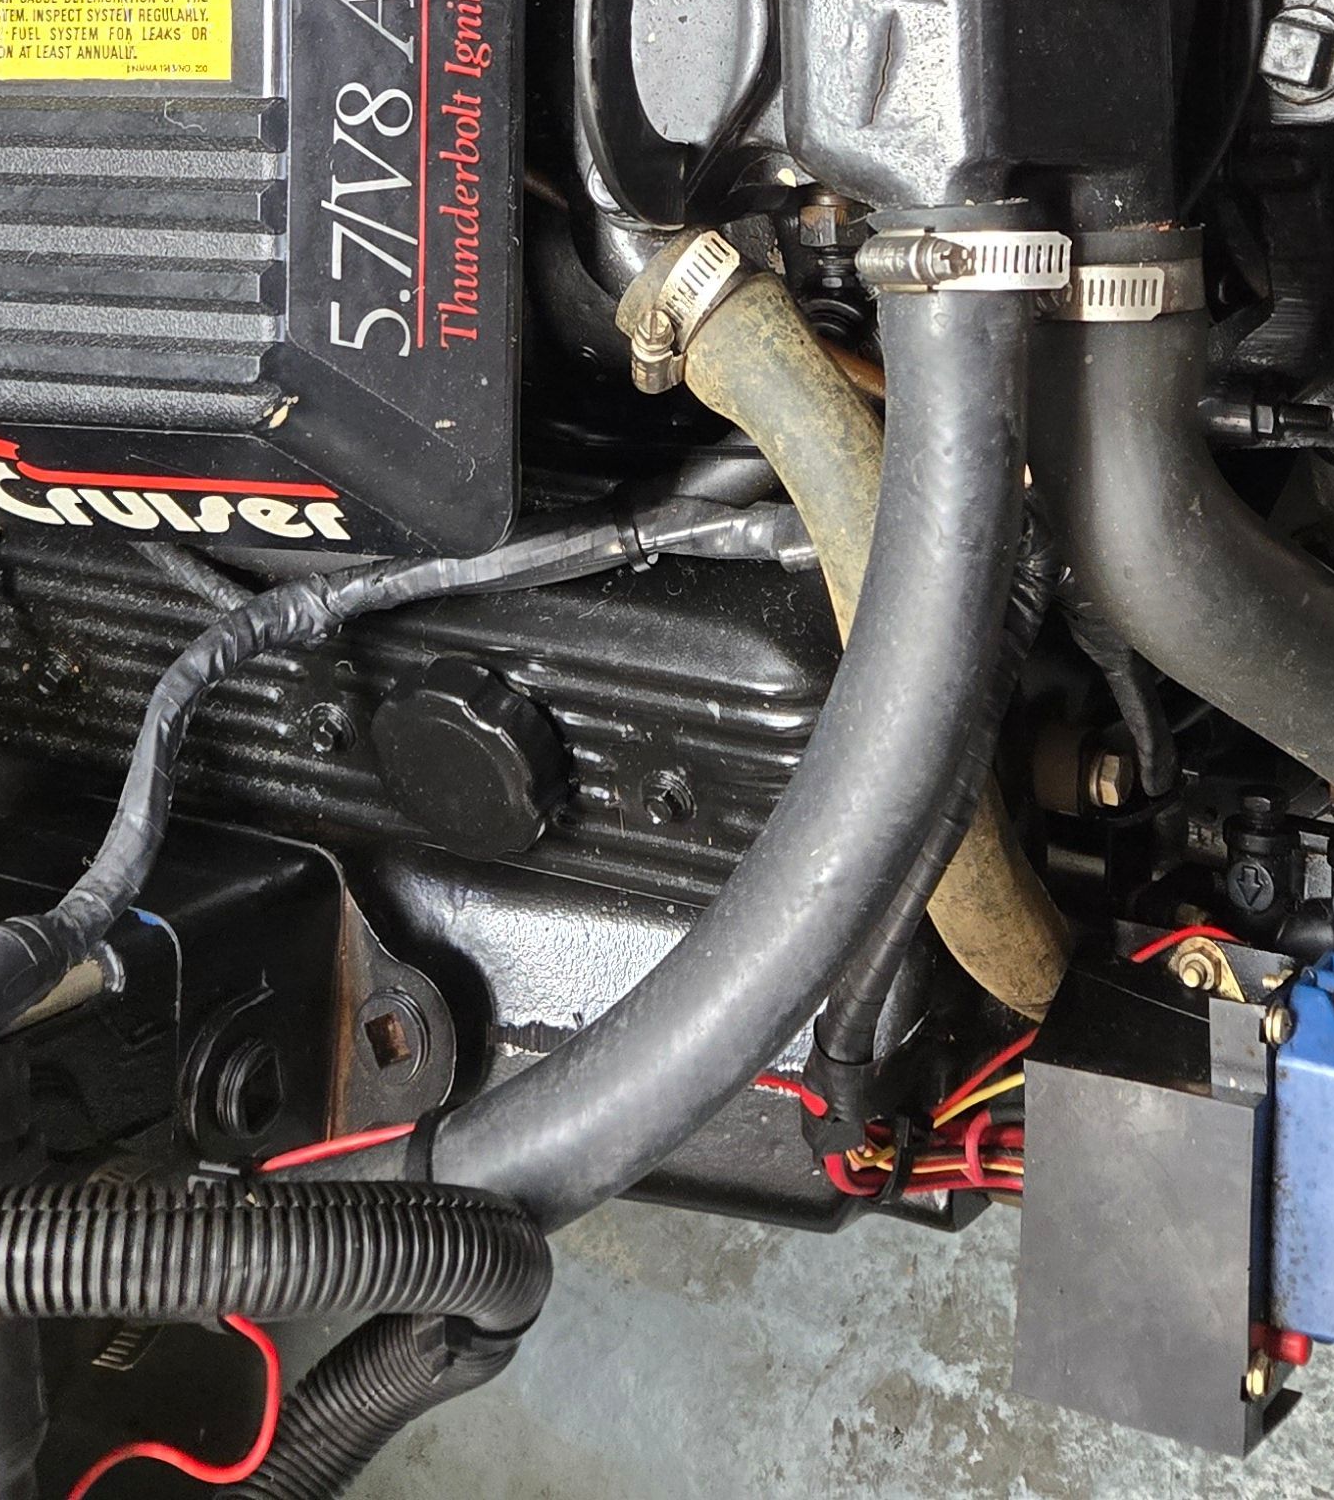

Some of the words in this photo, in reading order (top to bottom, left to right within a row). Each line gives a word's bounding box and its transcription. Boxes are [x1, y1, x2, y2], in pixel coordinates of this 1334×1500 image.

[33, 9, 81, 22] INSPECT
[86, 9, 132, 22] SYSTEM
[138, 8, 209, 22] REGULARLY.
[11, 28, 40, 41] FUEL
[50, 28, 98, 41] SYSTEM
[109, 27, 132, 41] FOR
[142, 27, 181, 41] LEAKS
[192, 27, 207, 40] OR
[19, 45, 31, 59] AT
[36, 45, 72, 59] LEAST
[320, 81, 419, 358] 5.7/V8
[438, 90, 483, 349] Thunderbolt
